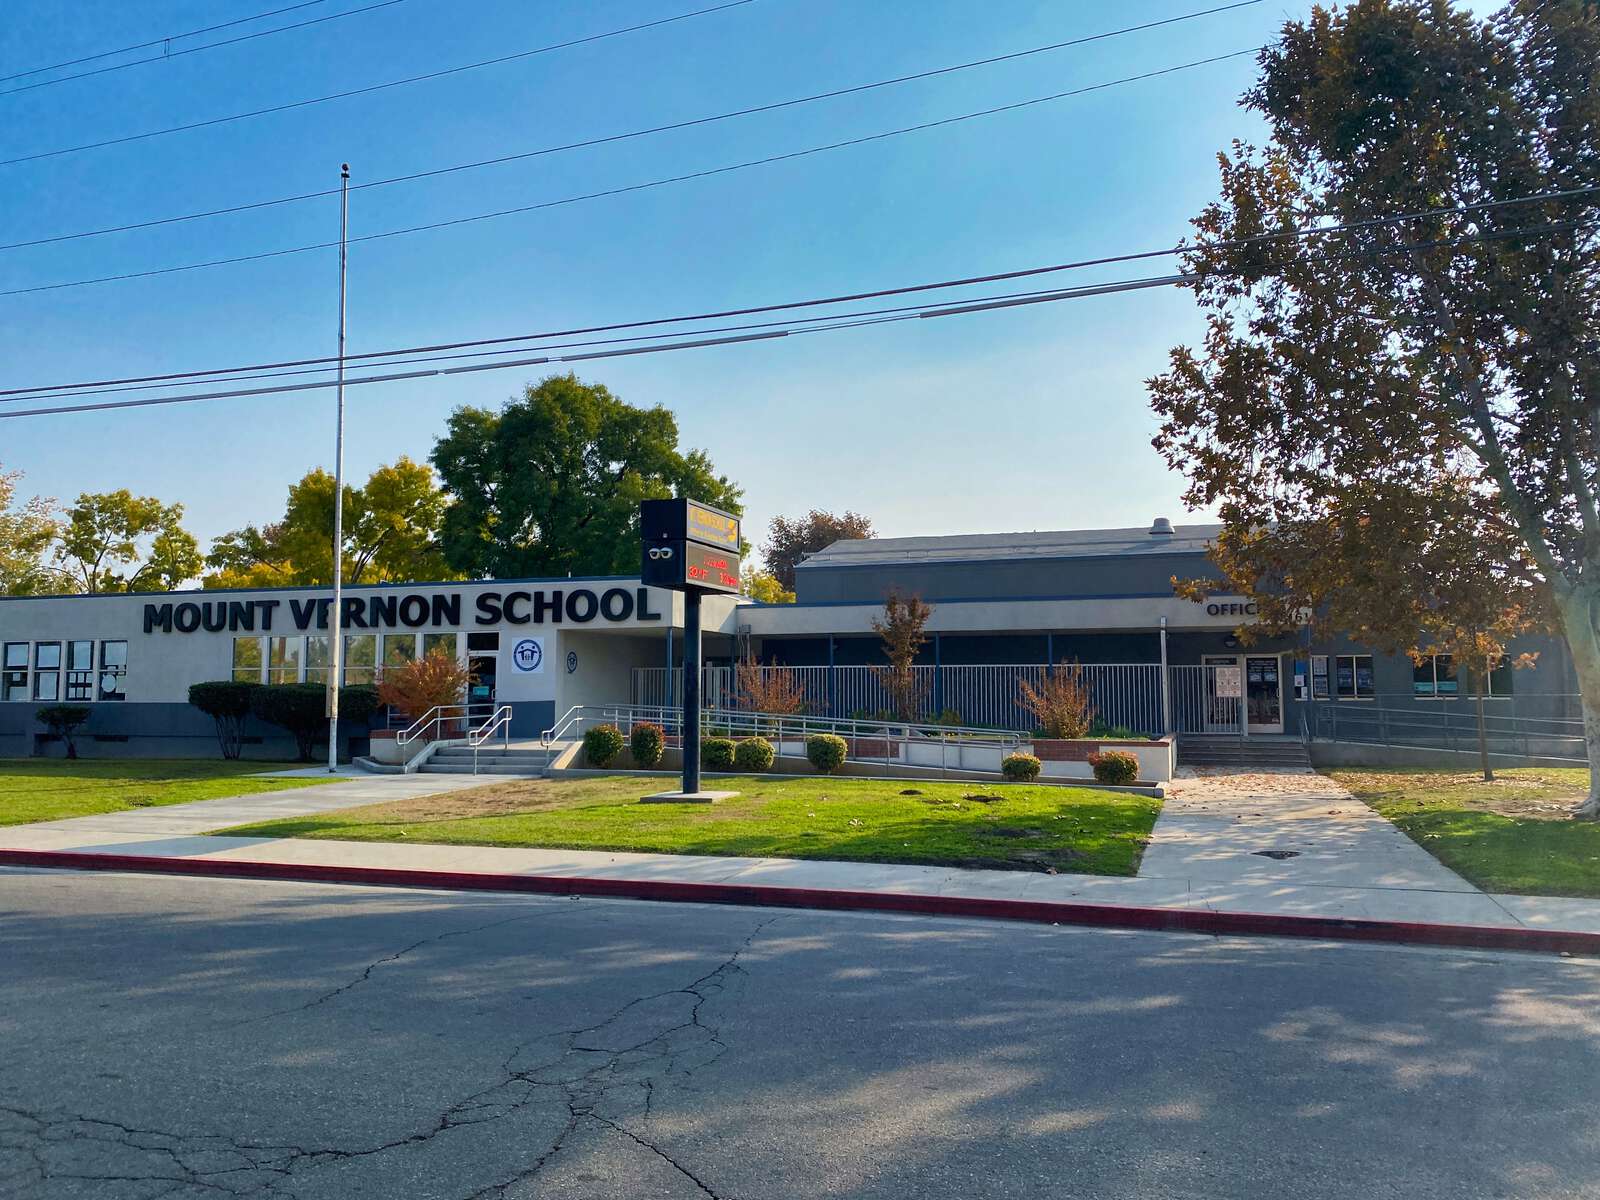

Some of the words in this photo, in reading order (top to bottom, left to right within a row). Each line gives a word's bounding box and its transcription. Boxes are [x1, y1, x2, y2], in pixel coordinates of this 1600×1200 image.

[143, 600, 281, 633] MOUNT
[475, 588, 661, 625] SCHOOL
[1206, 603, 1260, 616] OFFIC
